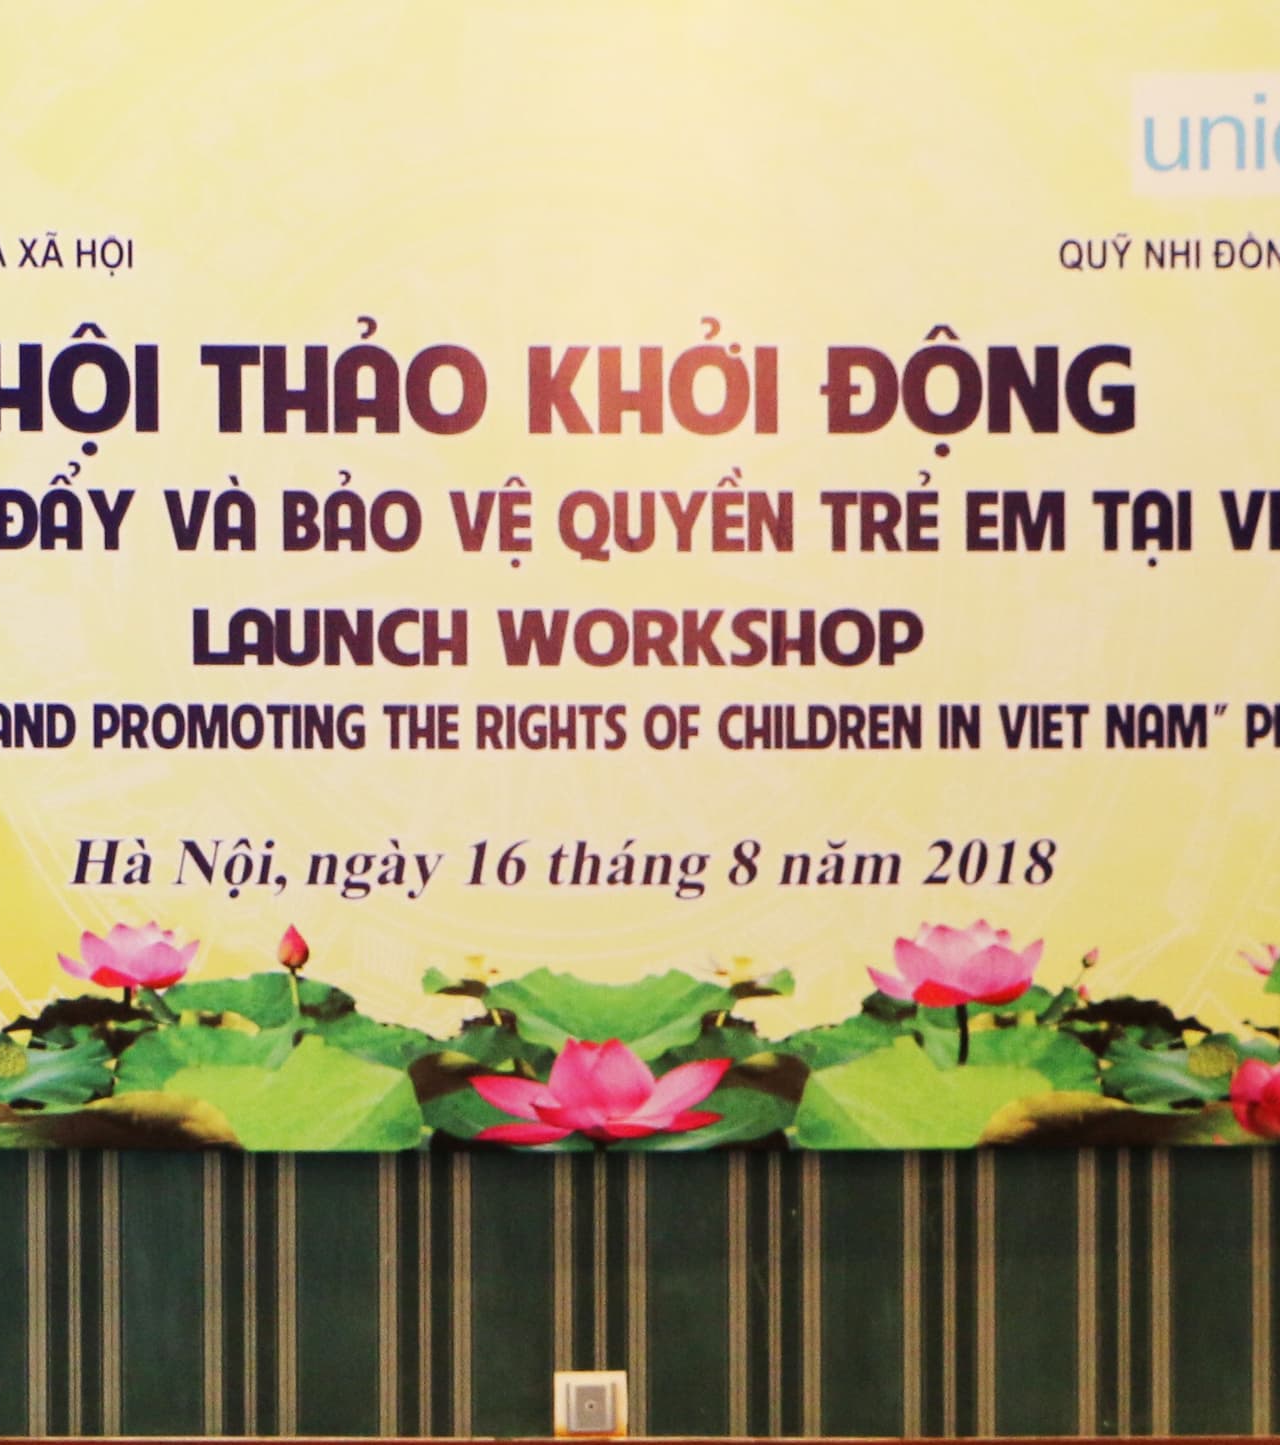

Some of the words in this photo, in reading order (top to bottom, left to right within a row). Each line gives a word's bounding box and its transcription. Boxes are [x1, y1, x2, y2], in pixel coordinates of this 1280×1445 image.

[17, 231, 65, 269] XÃ
[75, 232, 134, 278] HỘI
[1058, 232, 1133, 272] QUỸ
[1144, 238, 1202, 270] NHI
[199, 315, 488, 437] THẢO
[527, 315, 779, 436] KHỞI
[819, 323, 1137, 458] ĐỘNG
[162, 474, 258, 553] VÀ
[281, 469, 423, 554] BẢO
[448, 475, 533, 569] VỆ
[557, 465, 795, 563] QUYỀN
[819, 470, 940, 553] TRẺ
[964, 489, 1067, 553] EM
[1091, 488, 1193, 569] TẠI
[191, 606, 469, 668] LAUNCH
[496, 607, 925, 668] WORKSHOP
[92, 702, 367, 751] PROMOTING
[381, 703, 460, 751] THE
[475, 703, 628, 751] RIGHTS
[642, 704, 701, 752] OF
[717, 703, 923, 752] CHILDREN
[938, 703, 982, 751] IN
[997, 702, 1091, 751] VIET
[71, 835, 153, 886] Hà
[174, 837, 288, 900] Nội,
[305, 838, 444, 901] ngày
[468, 840, 527, 887] 16
[547, 838, 711, 900] tháng
[727, 839, 762, 887] 8
[778, 837, 902, 886] năm
[921, 838, 1058, 886] 2018
